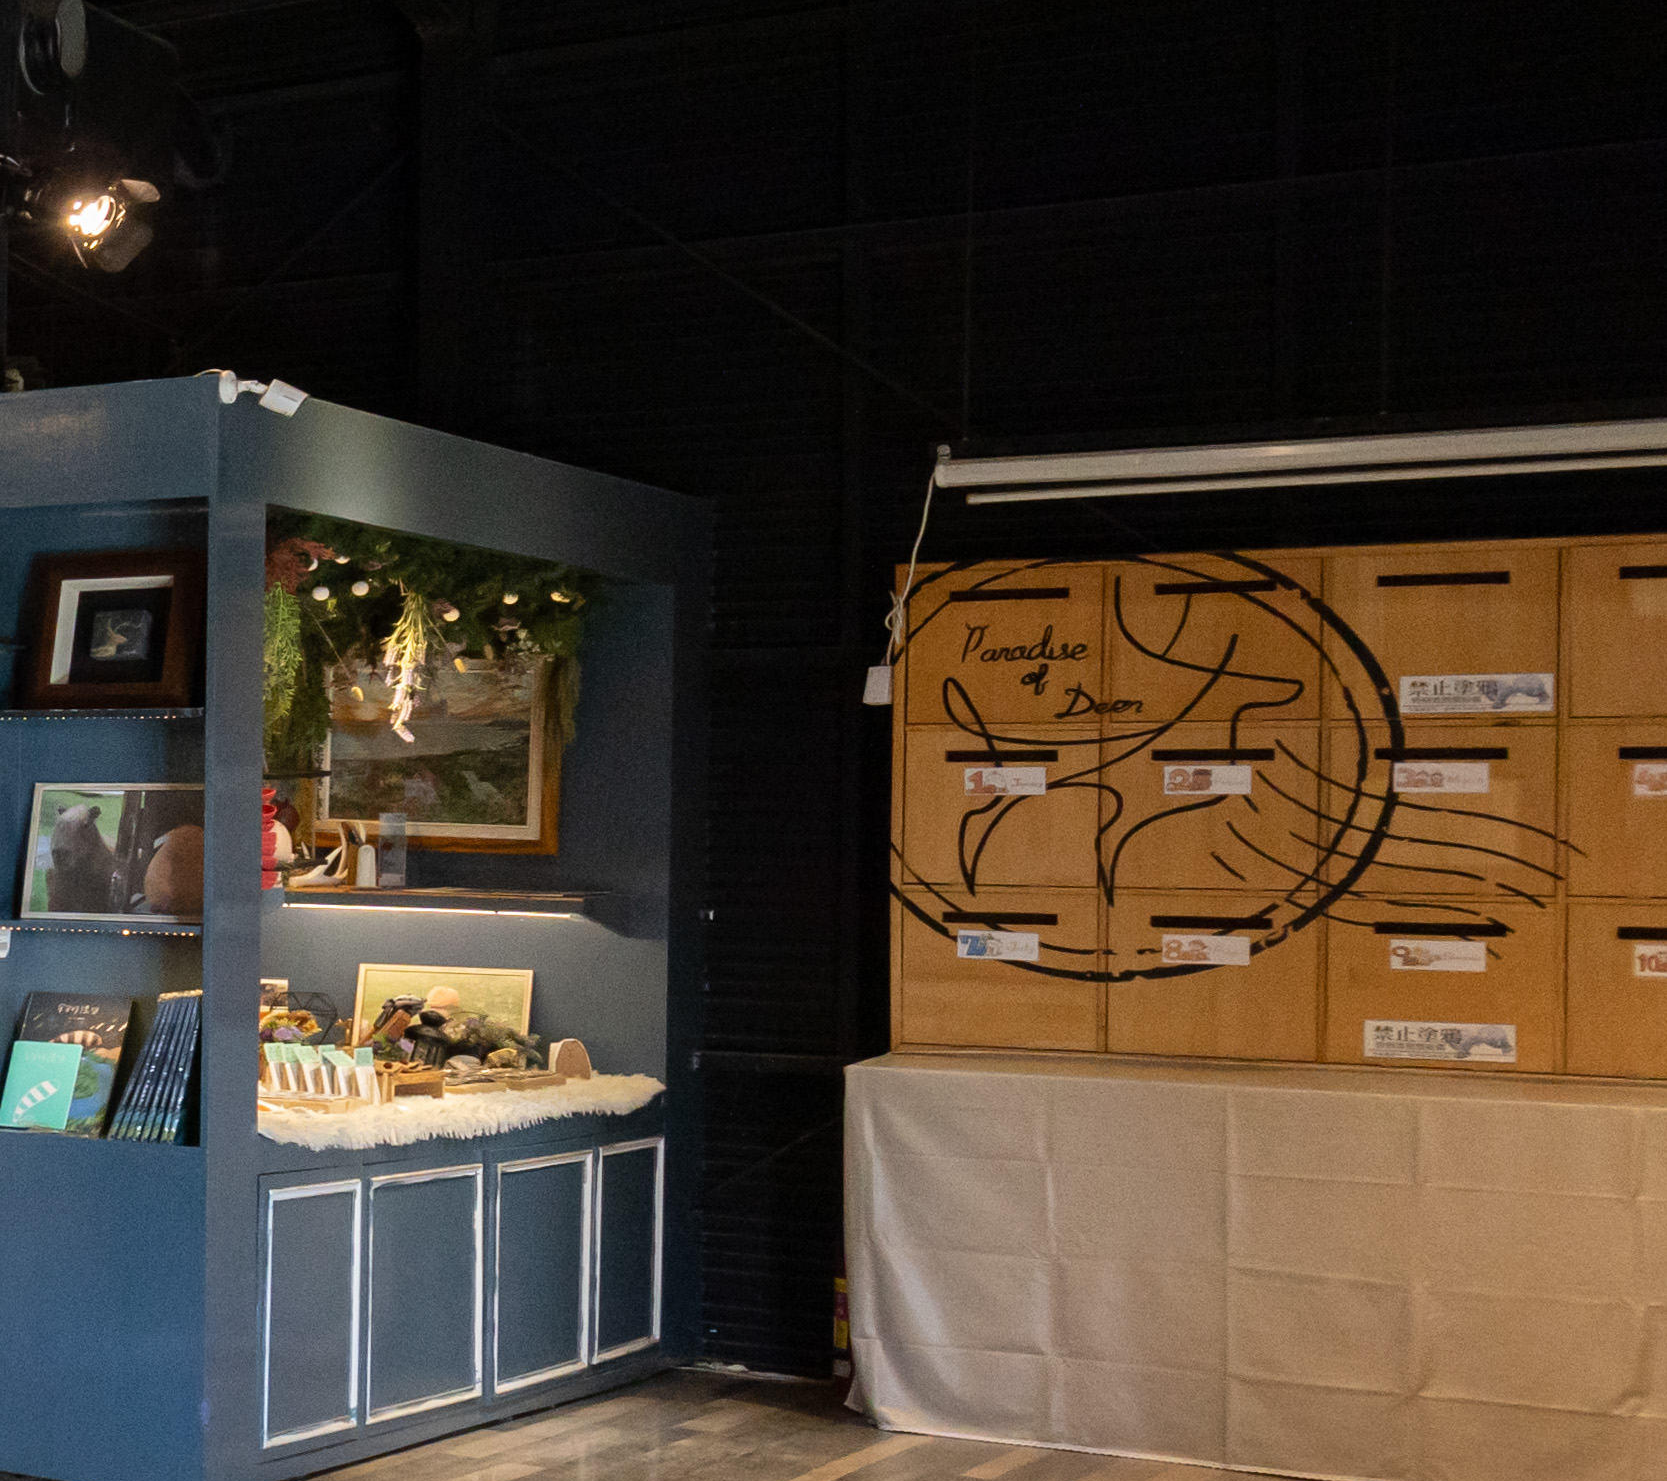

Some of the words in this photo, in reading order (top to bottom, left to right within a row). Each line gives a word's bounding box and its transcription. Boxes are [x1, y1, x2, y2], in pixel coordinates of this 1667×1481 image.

[962, 623, 1089, 663] Paradise
[1020, 663, 1050, 696] of
[1054, 682, 1144, 719] Deer
